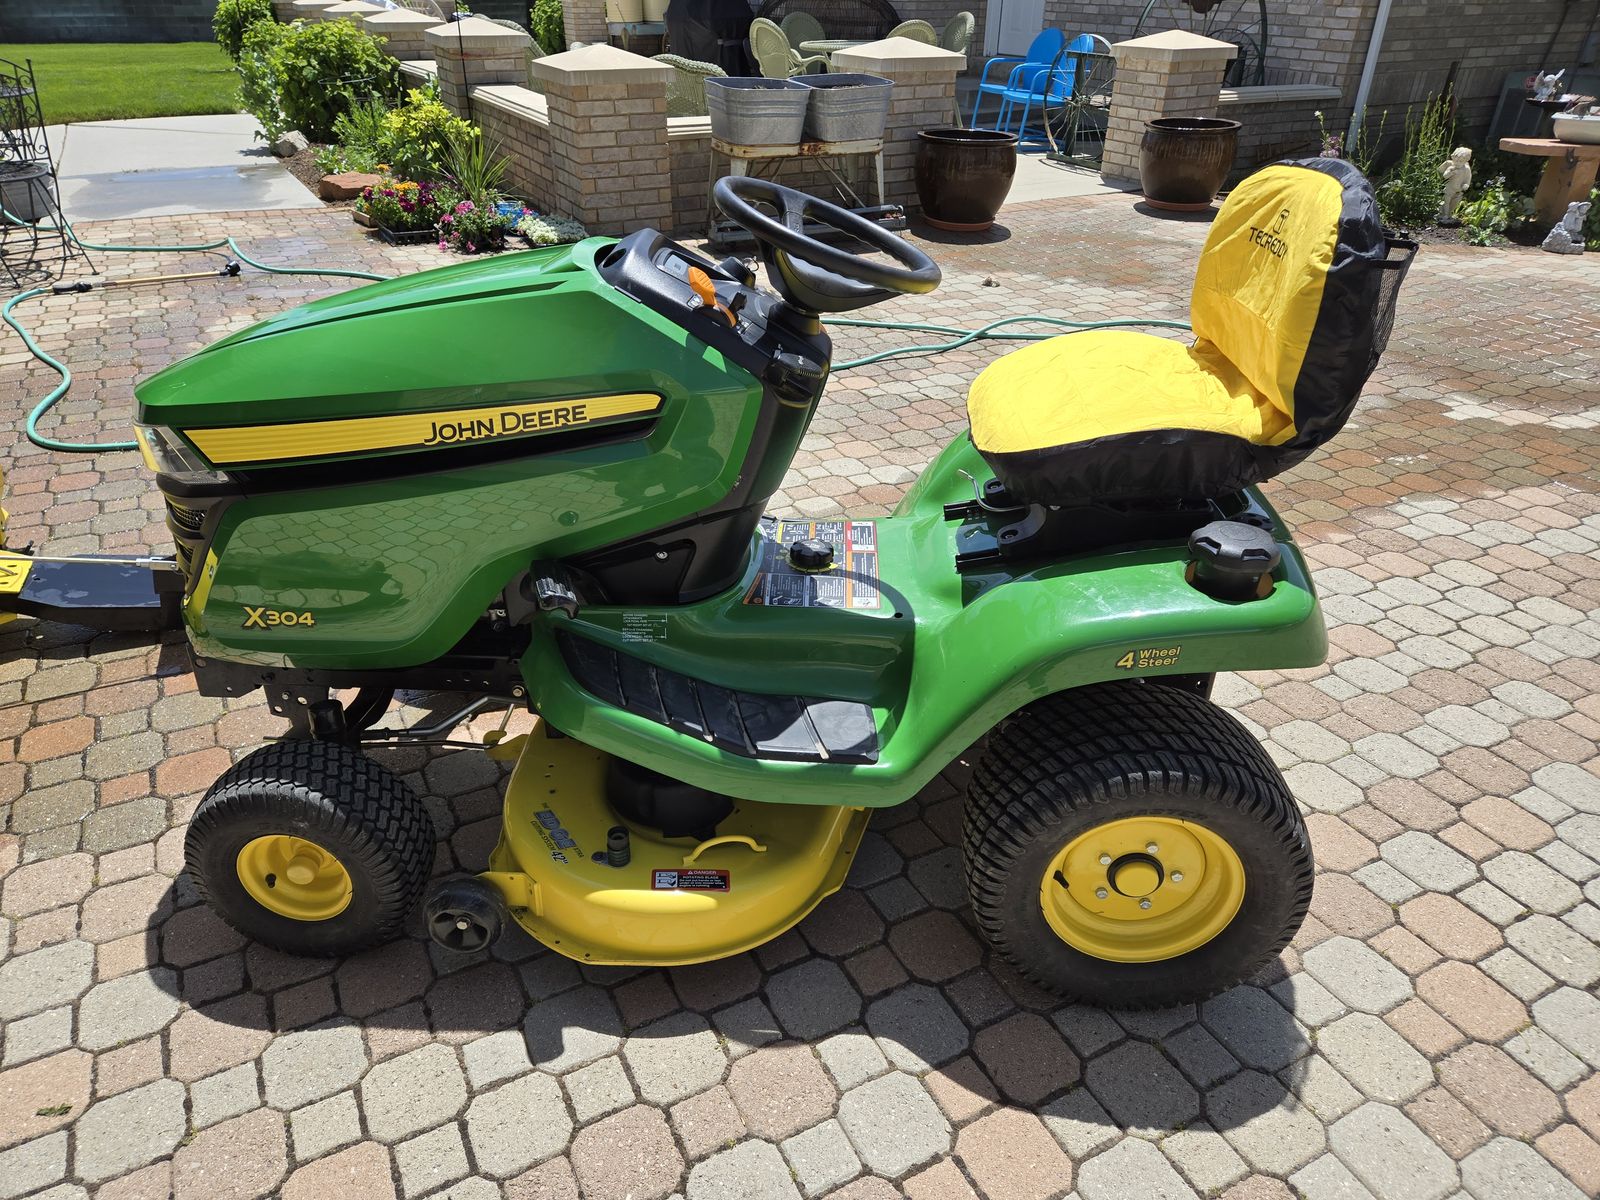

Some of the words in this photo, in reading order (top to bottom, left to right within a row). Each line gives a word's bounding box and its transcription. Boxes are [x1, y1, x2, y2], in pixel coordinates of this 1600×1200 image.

[423, 417, 496, 444] JOHN
[500, 403, 588, 433] DEERE
[243, 606, 316, 628] X304
[1116, 651, 1135, 669] 4
[1140, 646, 1181, 658] Wheel
[1138, 657, 1178, 668] Steer
[551, 851, 569, 864] 42"
